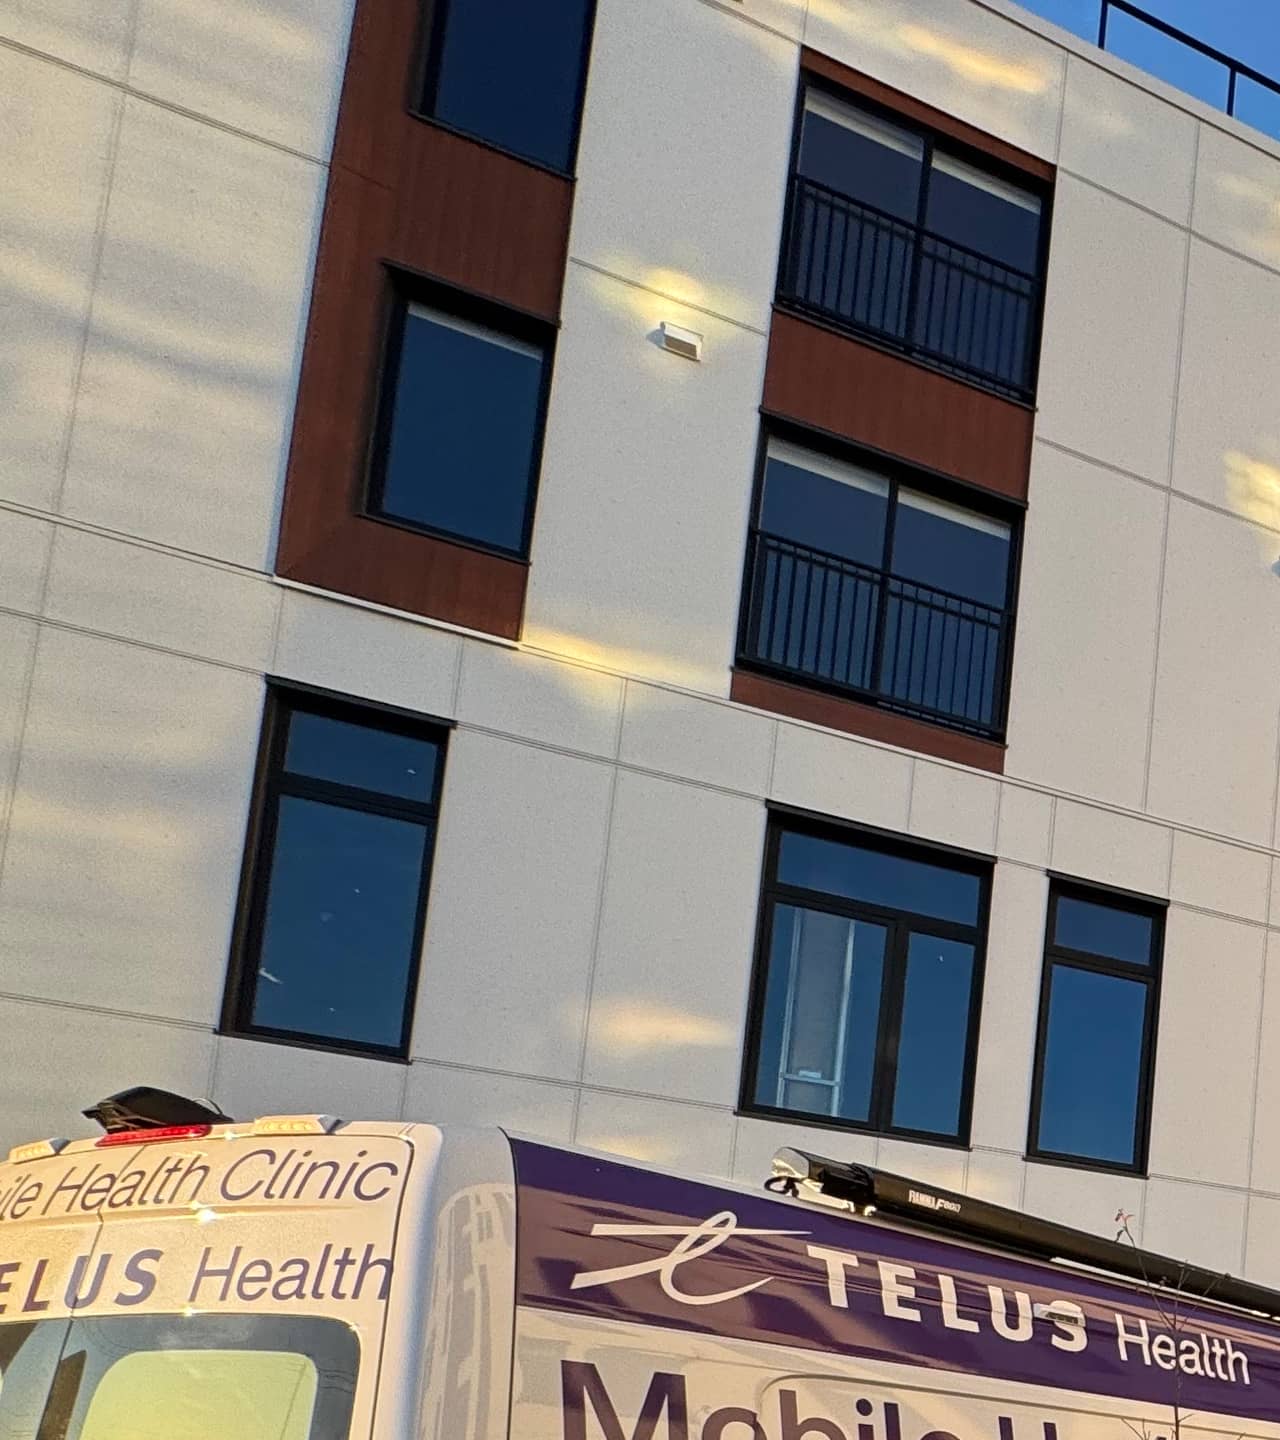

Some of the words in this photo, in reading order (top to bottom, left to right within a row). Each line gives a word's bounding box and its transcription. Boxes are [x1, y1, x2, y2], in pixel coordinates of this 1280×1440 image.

[0, 1174, 43, 1220] ile
[41, 1153, 208, 1215] Health
[220, 1148, 399, 1201] Clinic
[188, 1242, 395, 1304] Health
[806, 1243, 1087, 1352] TELUS
[1114, 1312, 1252, 1386] Health
